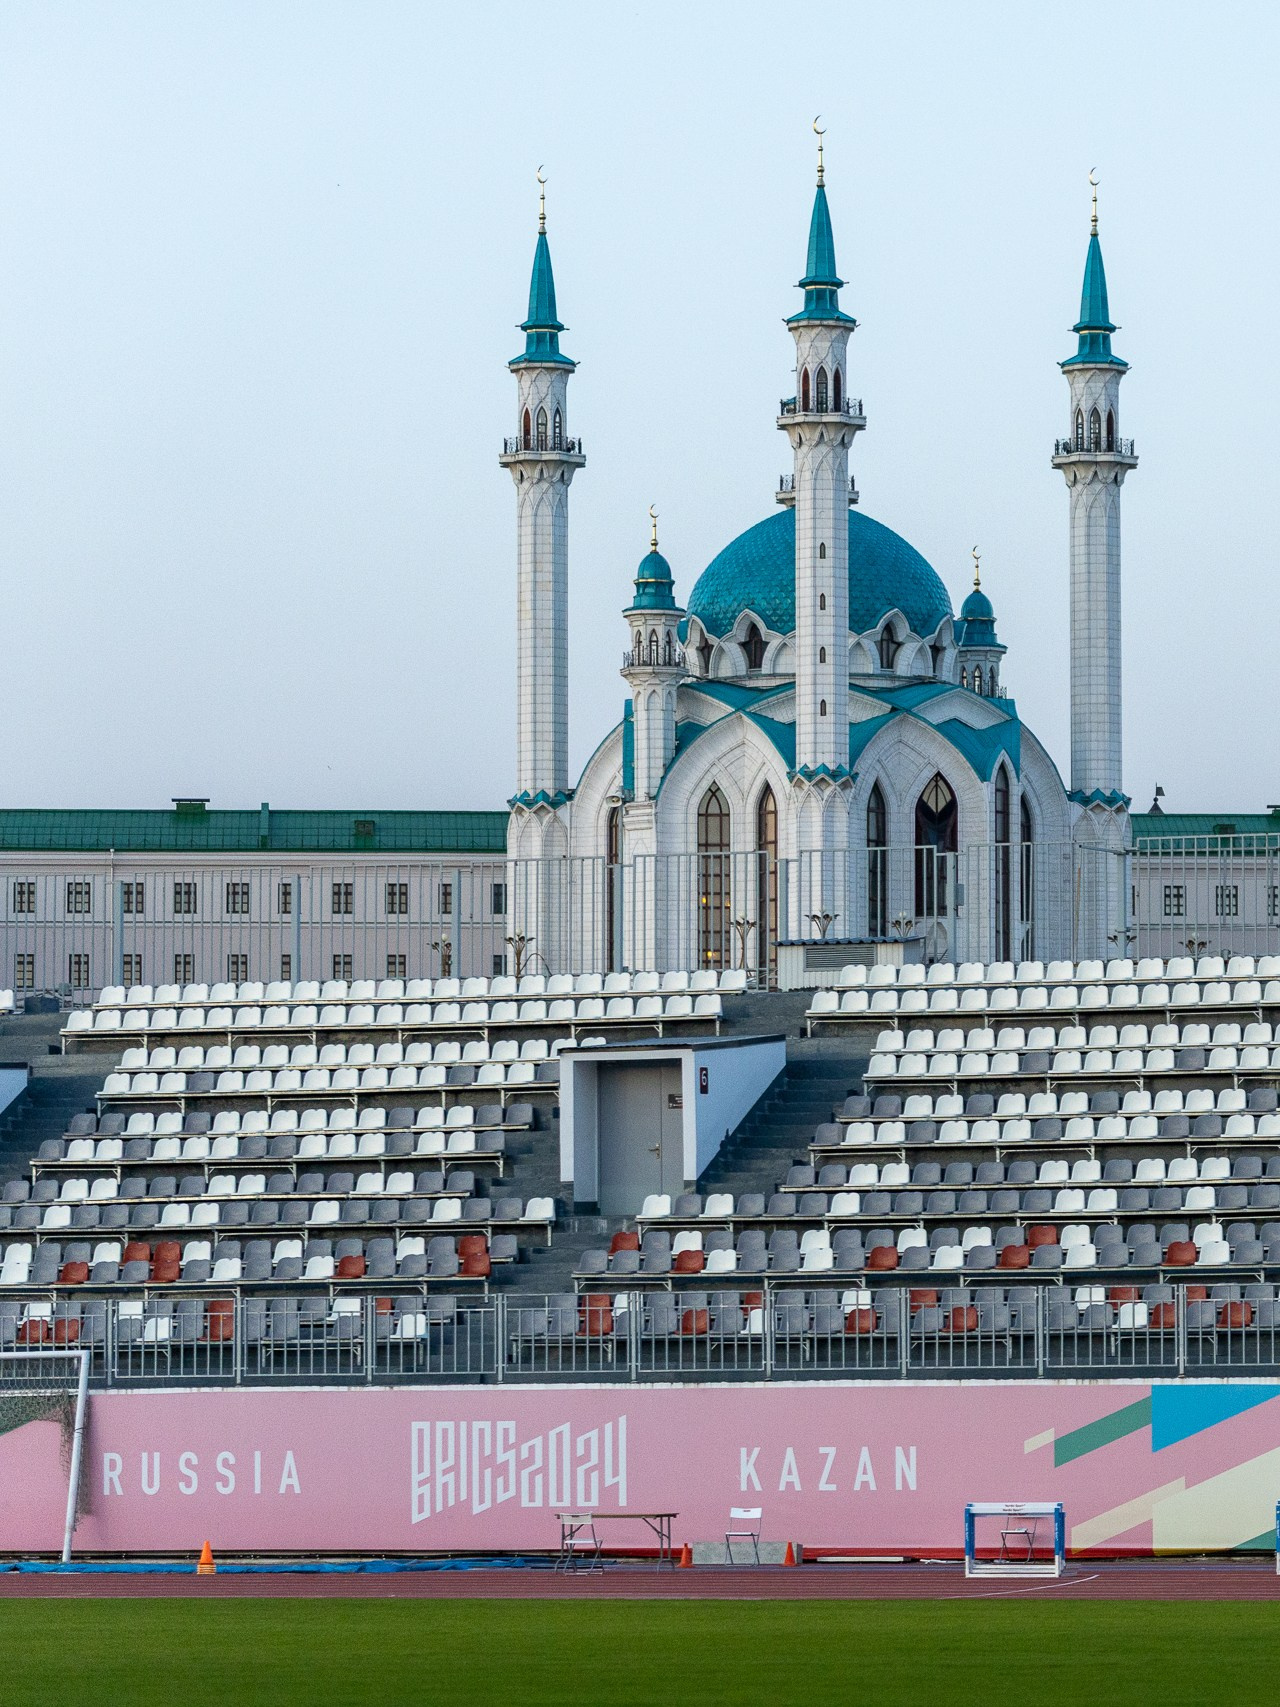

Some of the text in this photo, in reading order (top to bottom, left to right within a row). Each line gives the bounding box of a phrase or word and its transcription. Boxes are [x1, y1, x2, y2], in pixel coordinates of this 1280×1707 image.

[702, 1070, 707, 1086] 6
[103, 1451, 301, 1496] RUSSIA
[740, 1446, 917, 1492] KAZAN
